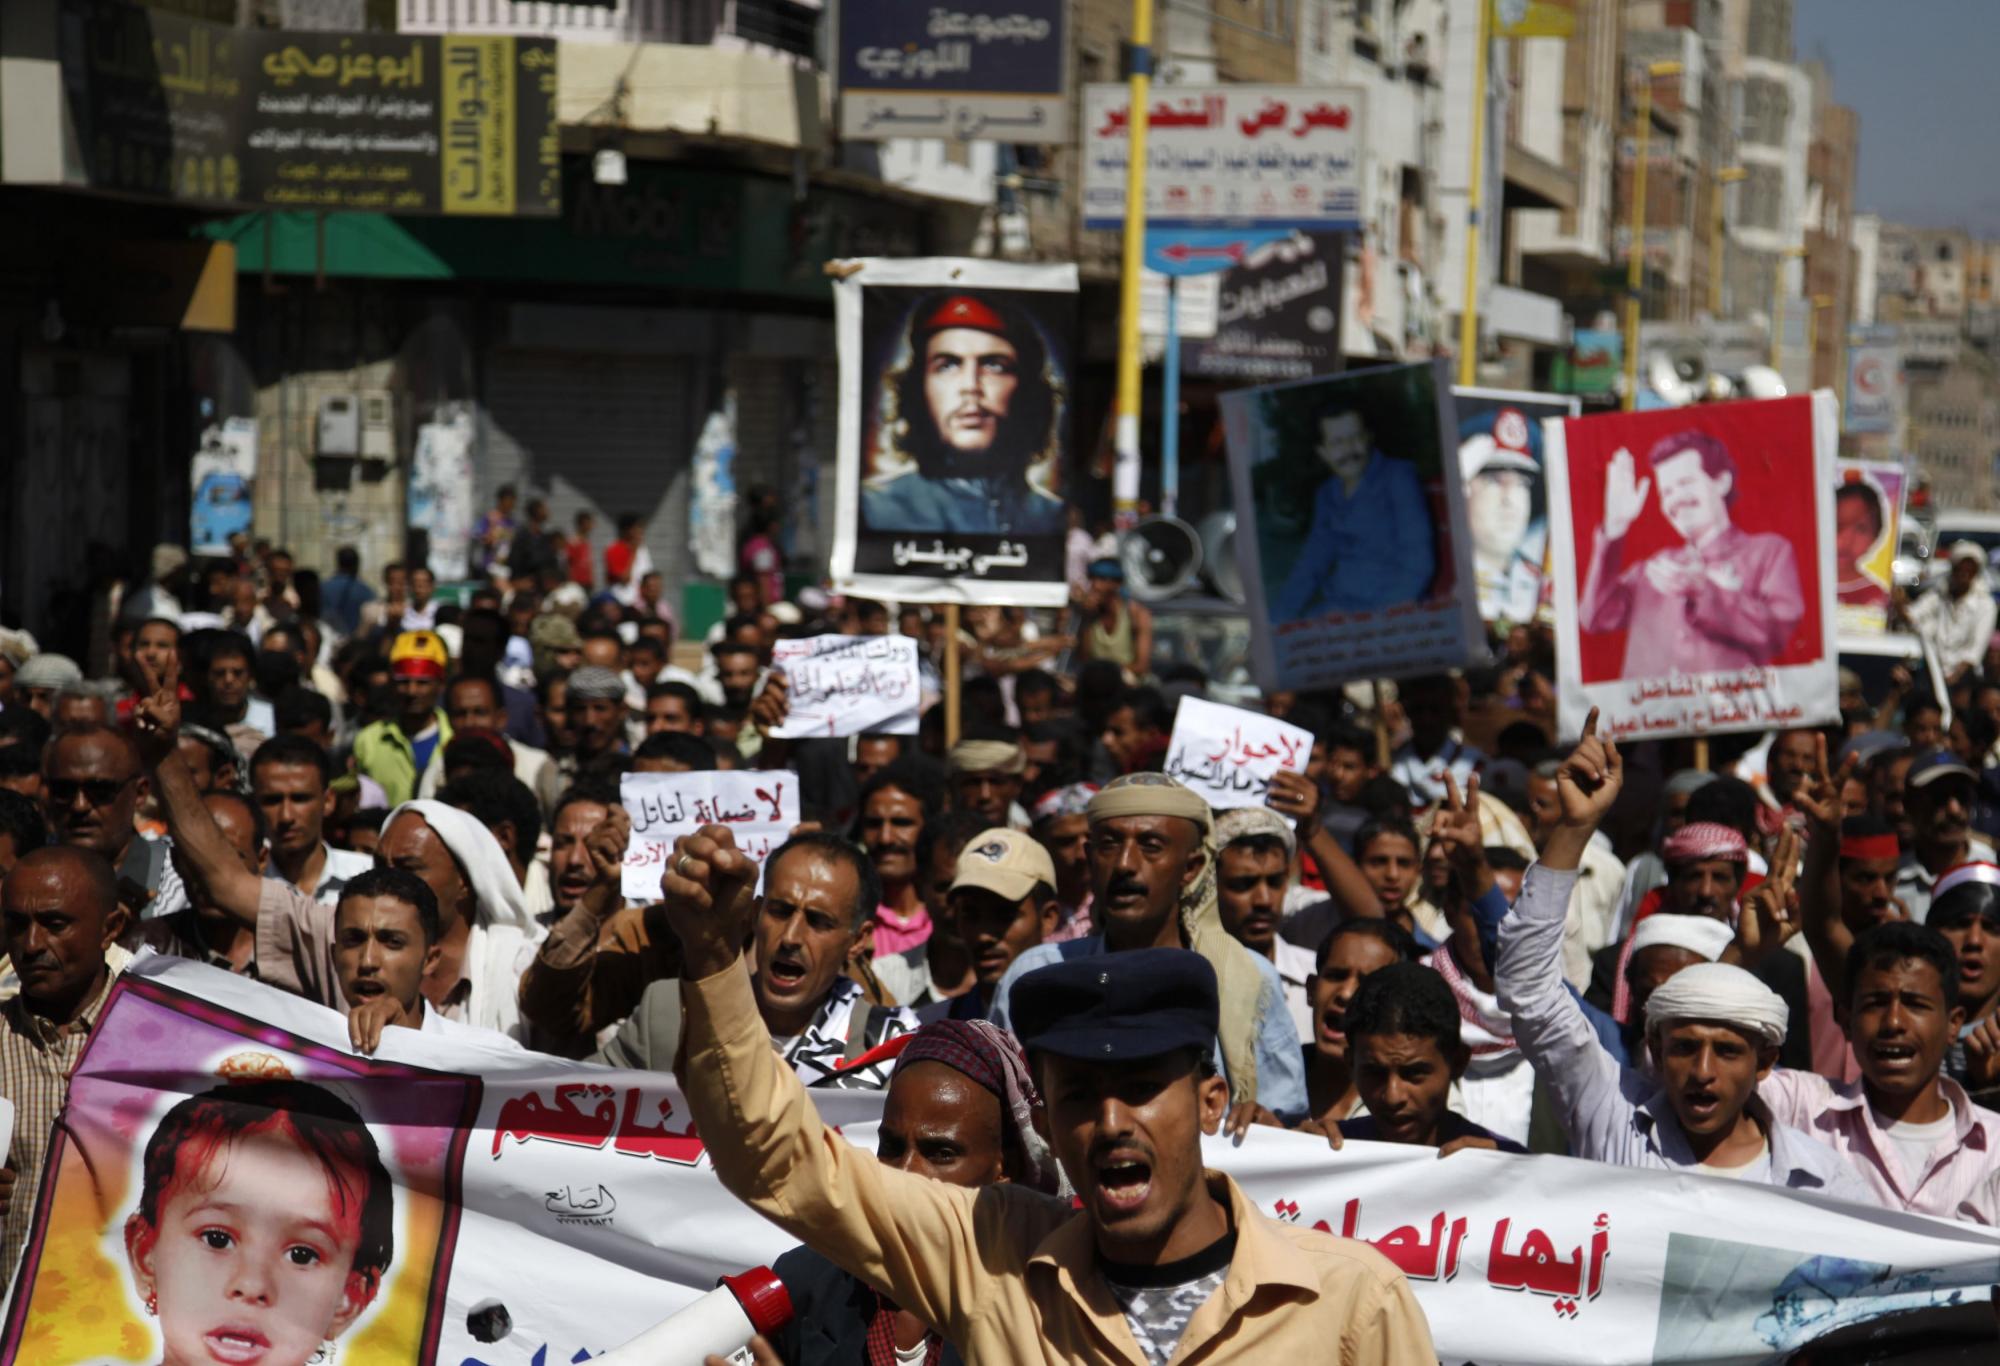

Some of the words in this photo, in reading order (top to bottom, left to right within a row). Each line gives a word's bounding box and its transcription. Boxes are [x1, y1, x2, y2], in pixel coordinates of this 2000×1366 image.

[926, 7, 1051, 44] مجموعة
[861, 99, 948, 131] تعز
[959, 105, 1045, 141] فرع
[1238, 97, 1352, 137] معرض
[893, 540, 973, 571] جيفارا
[972, 540, 1028, 575] تشي
[633, 791, 685, 833] لقاتل
[694, 795, 757, 825] ضمانة
[755, 782, 784, 822] لا
[1487, 1212, 1610, 1319] أيها
